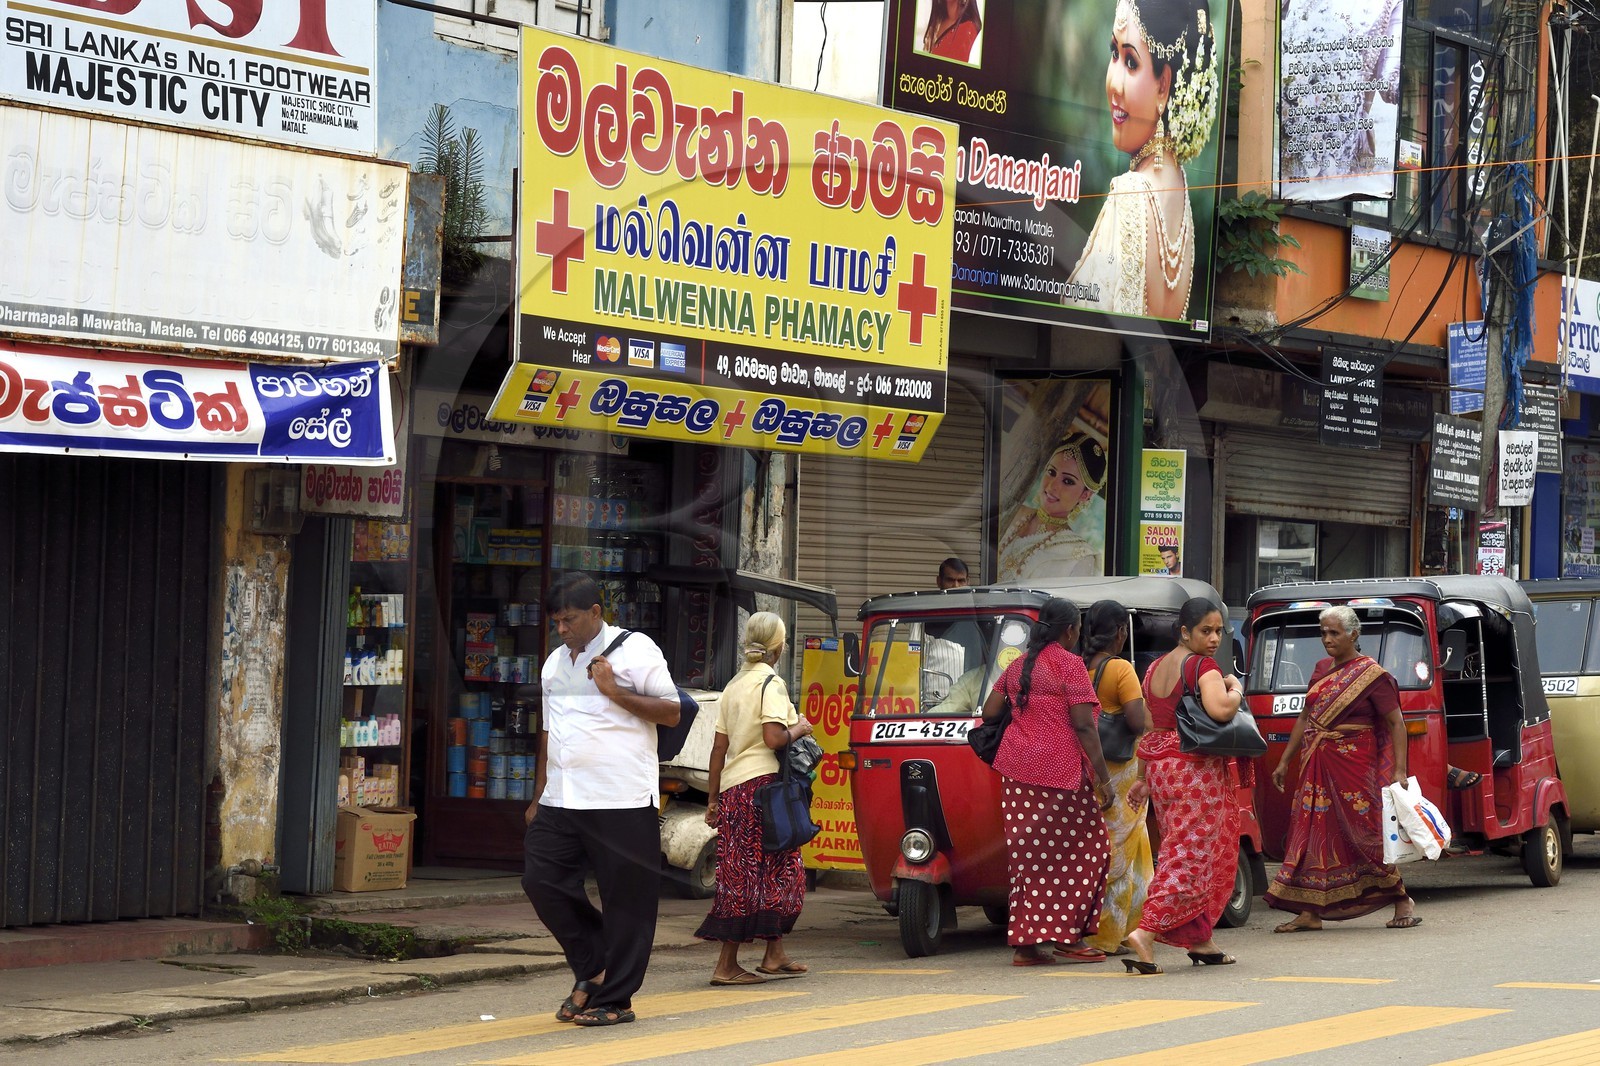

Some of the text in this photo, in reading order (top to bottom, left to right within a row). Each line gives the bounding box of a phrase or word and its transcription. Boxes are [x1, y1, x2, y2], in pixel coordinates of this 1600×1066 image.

[6, 17, 52, 47] SRI
[65, 27, 177, 69] LANKA's
[188, 50, 236, 81] No.1
[246, 61, 370, 103] FOOTWEAR
[26, 51, 270, 127] MAJESTIC CITY
[281, 95, 317, 111] MAJESTIC
[319, 101, 335, 114] SHOE
[300, 110, 342, 127] DHARMAPALA
[536, 46, 790, 198] මල්වැන්න
[968, 137, 1081, 211] Dananjani
[982, 211, 1022, 233] Mawatha,
[1025, 219, 1055, 238] Matale.
[595, 195, 896, 297] மல்வென்ன பாமசி
[980, 235, 1055, 267] 071-7335381
[951, 262, 999, 287] Dananjani
[594, 268, 892, 353] MALWENNA PHAMACY
[82, 313, 147, 336] Mawatha,
[150, 321, 197, 338] Matale.
[201, 326, 220, 341] Tel
[224, 330, 246, 343] 066
[250, 331, 304, 351] 4904125,
[307, 337, 328, 351] 077
[332, 338, 384, 356] 6013494.
[543, 325, 587, 346] We Accept
[572, 349, 591, 364] Hear
[633, 347, 650, 360] VISA
[660, 349, 685, 358] AMERICAN
[664, 358, 686, 368] EXPRESS
[256, 367, 374, 398] පාවහන්
[717, 355, 731, 378] 49,
[875, 376, 892, 395] 066
[895, 377, 932, 400] 2230008
[524, 401, 542, 411] VISA
[288, 408, 352, 448] සේල්
[897, 441, 911, 451] VISA
[1144, 536, 1179, 546] TOONA
[1147, 525, 1176, 536] SALON
[875, 722, 968, 740] 201-4524
